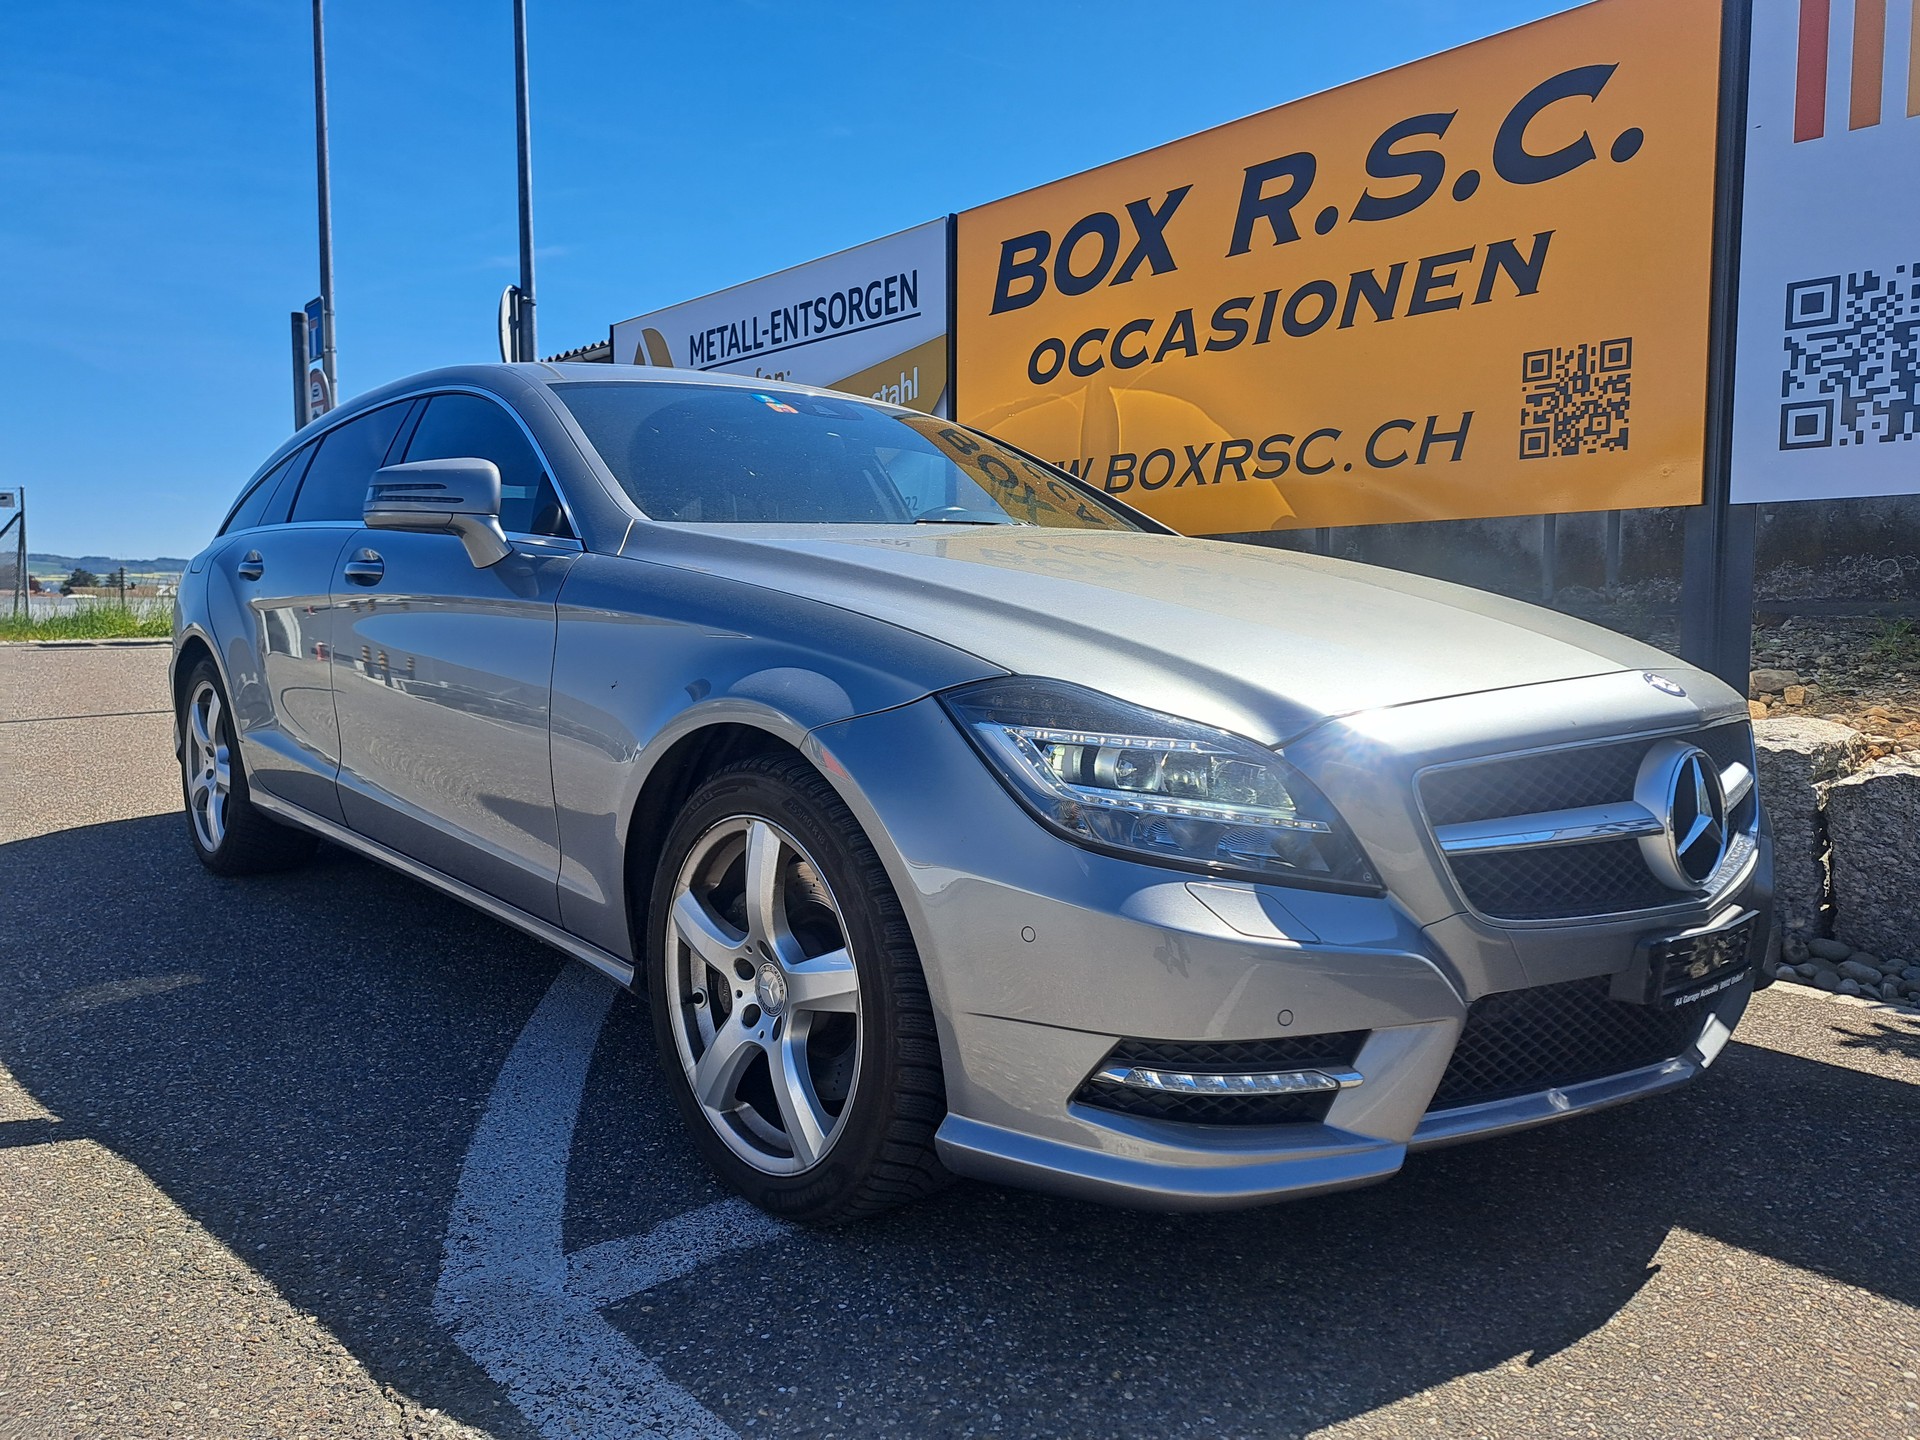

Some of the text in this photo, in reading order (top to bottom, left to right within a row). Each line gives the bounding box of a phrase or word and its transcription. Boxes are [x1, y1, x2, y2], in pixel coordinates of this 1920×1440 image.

[989, 62, 1644, 315] BOX R.S.C.
[689, 269, 918, 366] METALL-ENTSORGEN
[1027, 230, 1556, 385] OCCASIONEN
